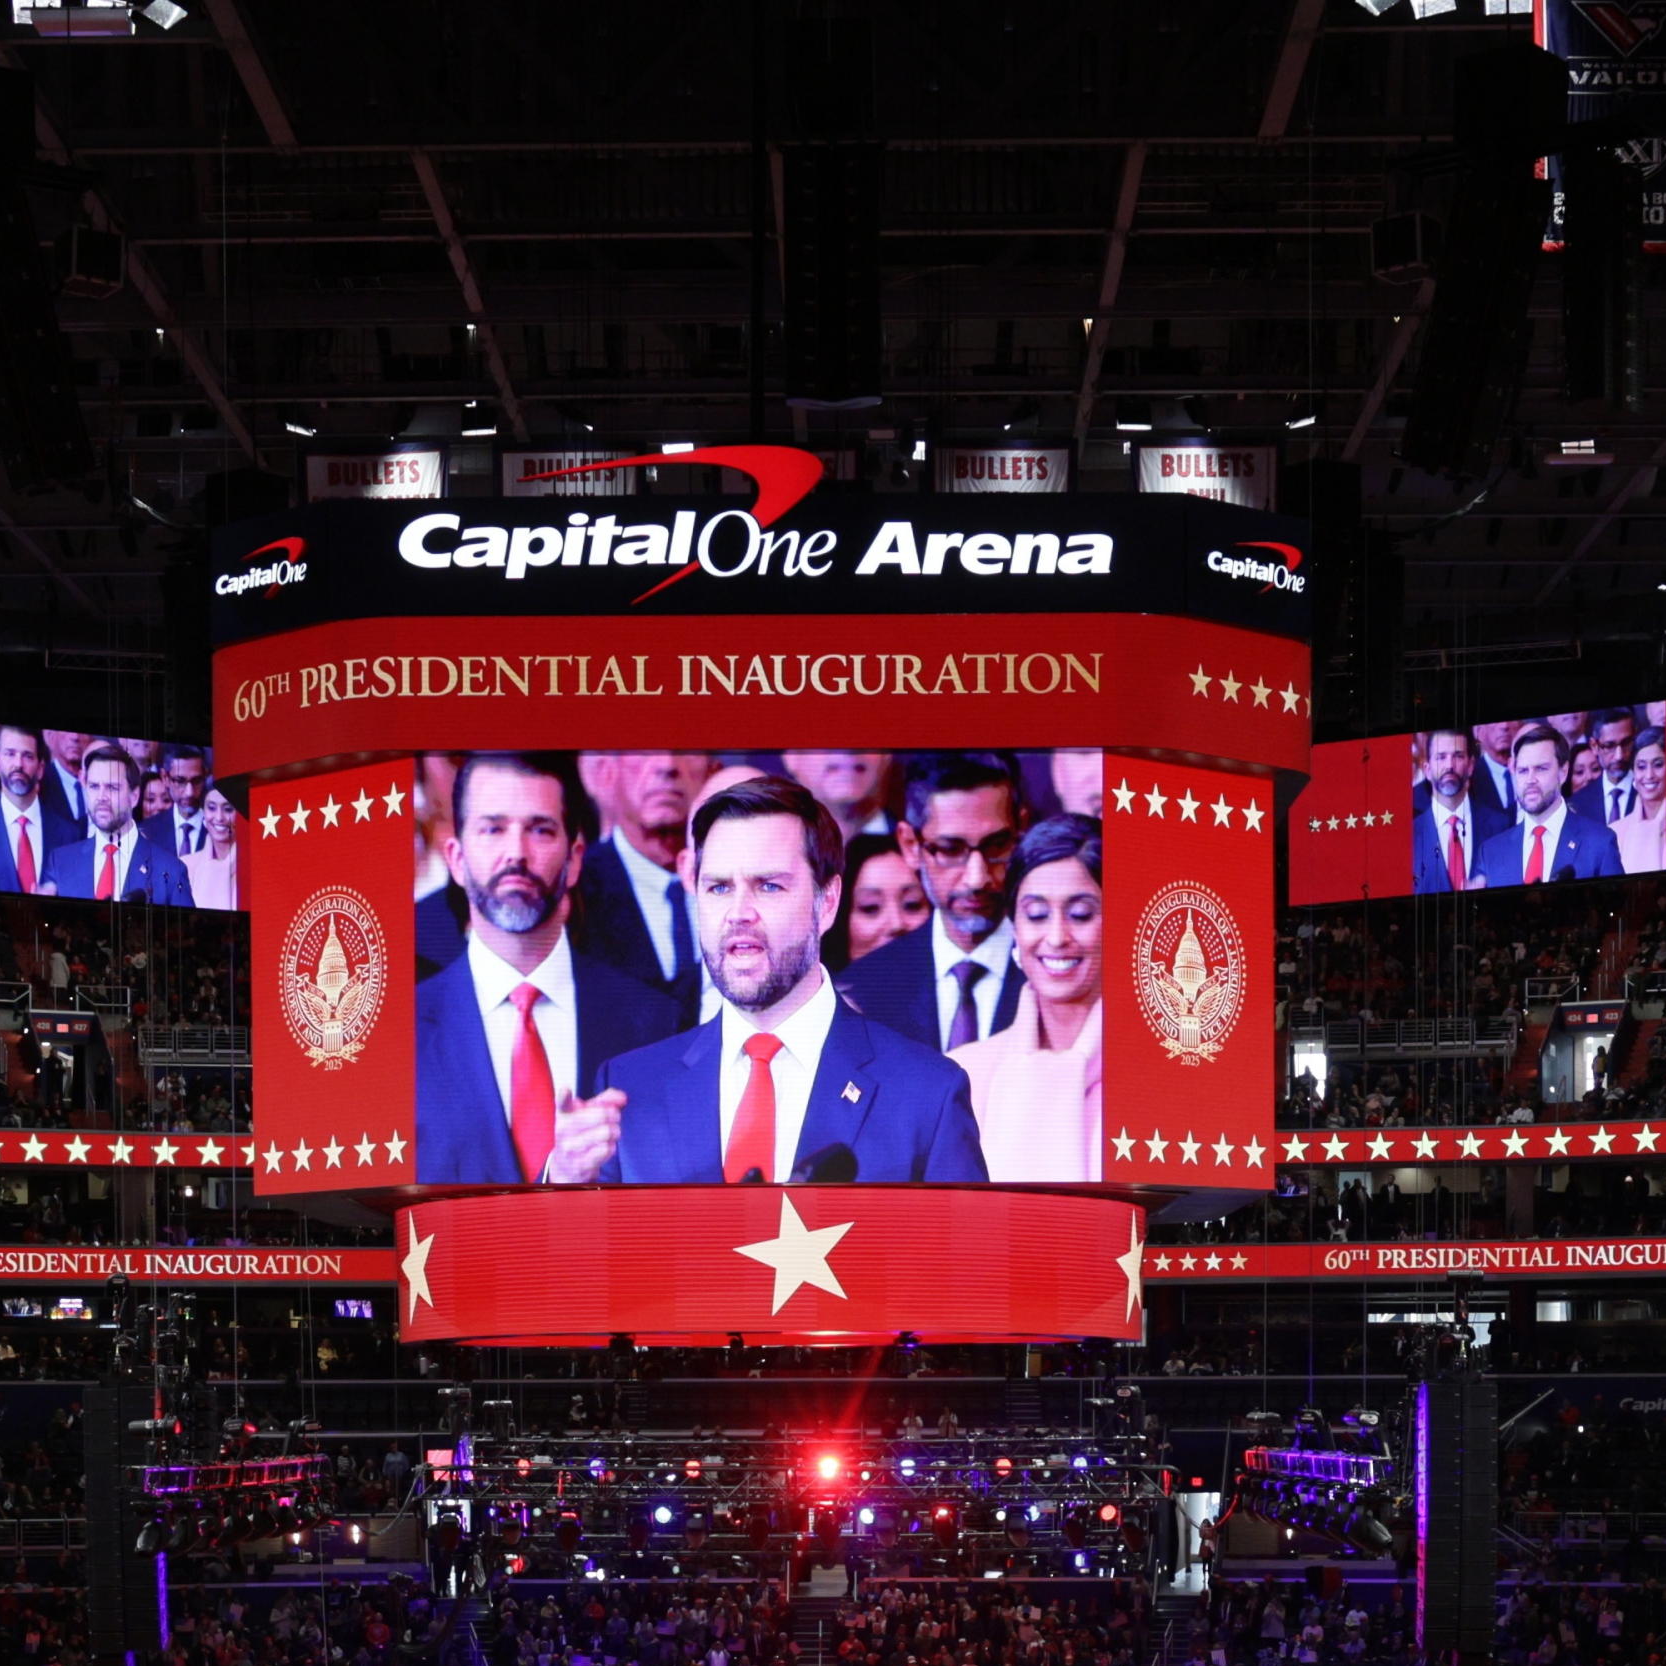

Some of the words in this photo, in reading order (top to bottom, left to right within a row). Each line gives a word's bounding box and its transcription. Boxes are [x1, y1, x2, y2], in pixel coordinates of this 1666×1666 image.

[327, 459, 420, 486] BULLETS
[955, 457, 1049, 481] BULLETS
[1160, 453, 1255, 478] BULLETS
[855, 520, 1115, 577] Arena
[233, 671, 292, 722] 60TH
[299, 655, 664, 710] PRESIDENTIAL
[677, 652, 1104, 696] INAUGURATION
[294, 896, 361, 942] INAUGURATION
[358, 913, 372, 931] OF
[1148, 892, 1220, 928] INAUGURATION
[1216, 917, 1232, 936] OF
[285, 954, 305, 1029] PRESIDENT
[302, 1026, 323, 1048] AND
[343, 1019, 366, 1043] VICE
[361, 942, 382, 1020] PRESIDENT
[1140, 938, 1162, 1016] PRESIDENT
[1157, 1015, 1179, 1038] AND
[1202, 1021, 1224, 1042] VICE
[1219, 947, 1240, 1023] PRESIDENT
[323, 1059, 344, 1072] 2025
[1180, 1054, 1202, 1068] 2025
[144, 1253, 343, 1277] INAUGURATION
[1324, 1248, 1370, 1271] 60TH
[1376, 1246, 1561, 1271] PRESIDENTIAL
